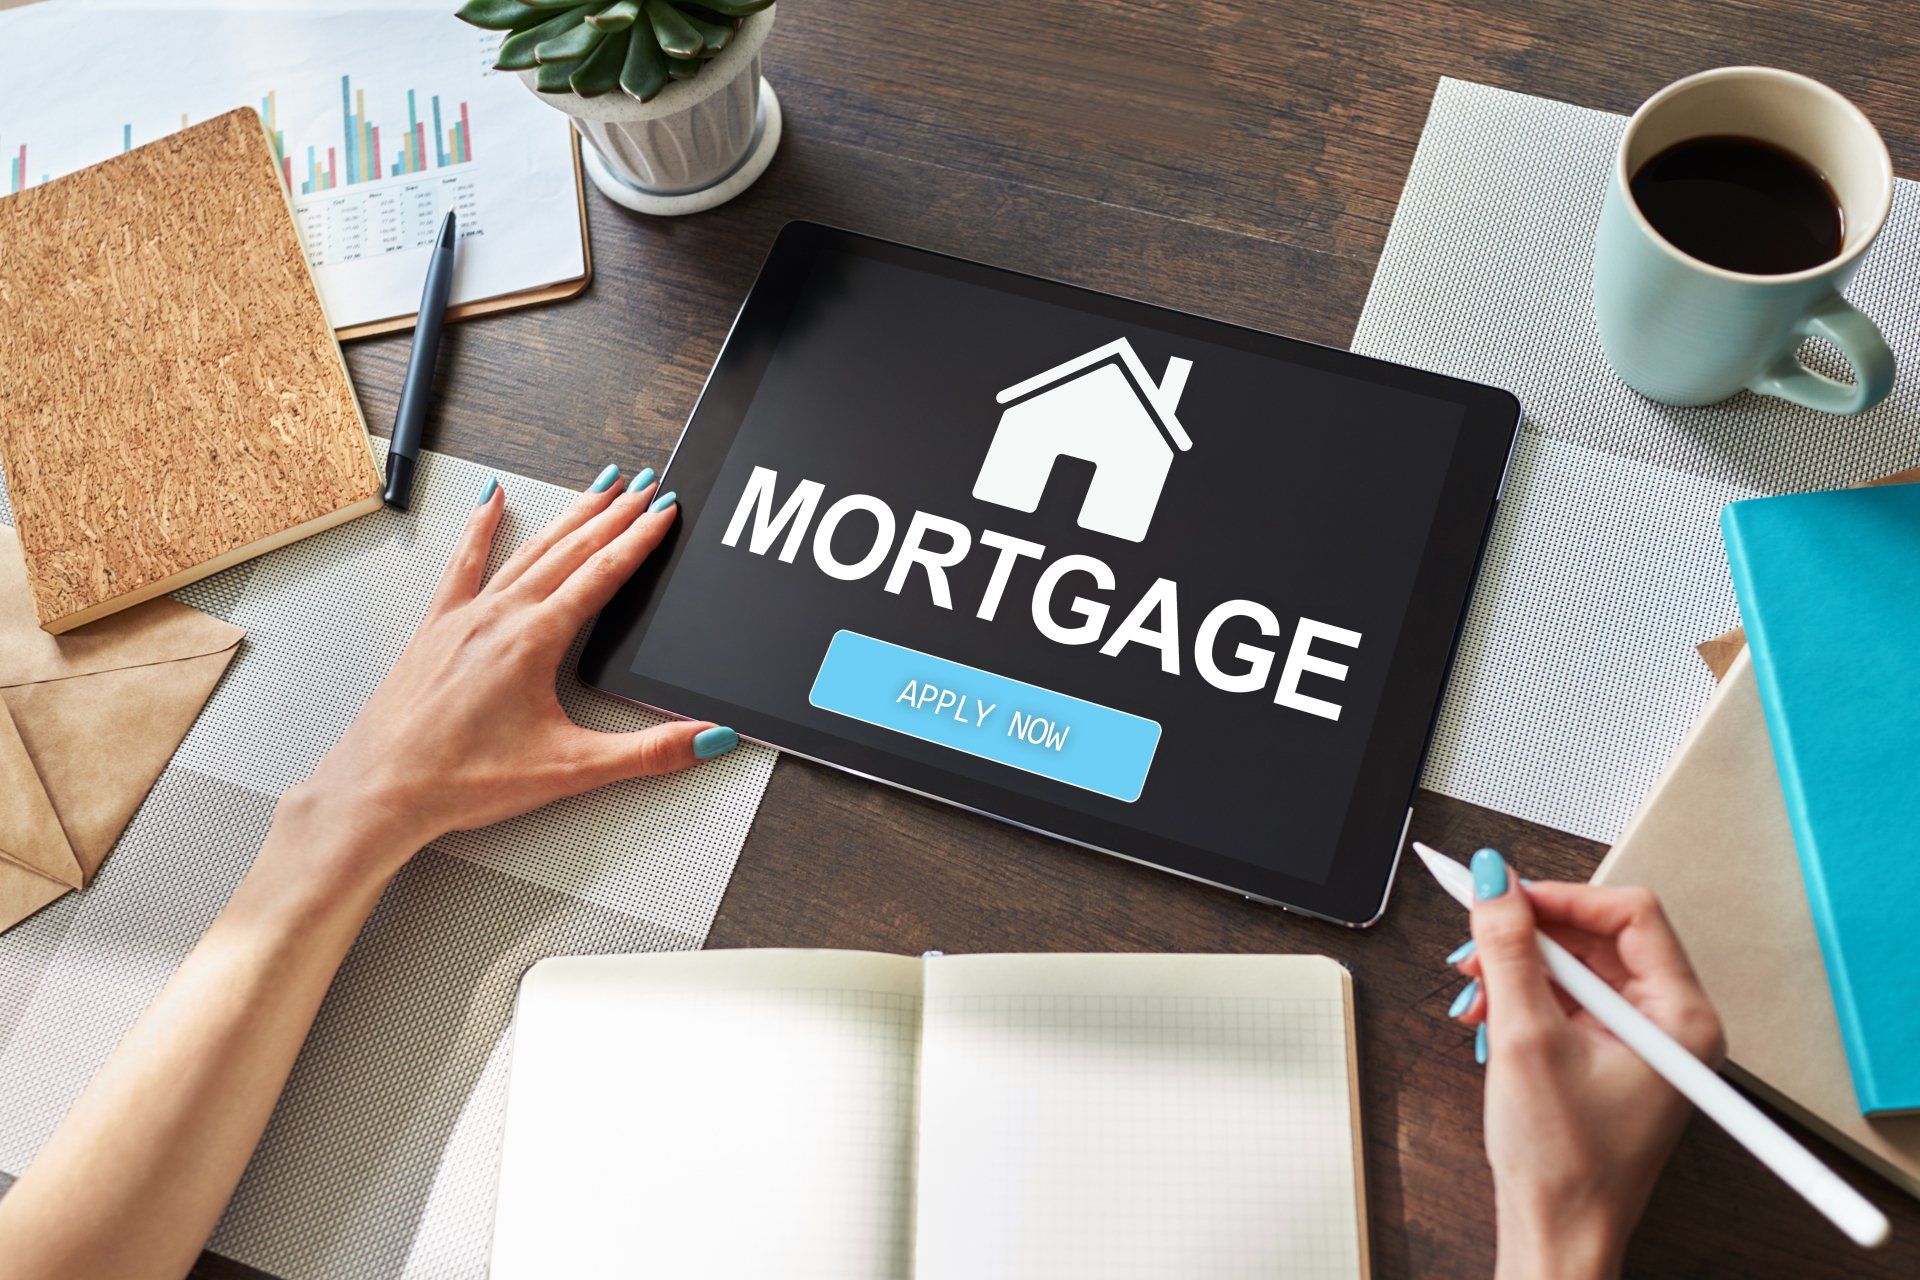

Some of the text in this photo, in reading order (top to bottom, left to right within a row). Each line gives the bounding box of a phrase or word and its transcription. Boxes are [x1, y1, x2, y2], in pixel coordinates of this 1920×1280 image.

[721, 466, 1362, 721] MORTGAGE
[896, 680, 1070, 752] APPLY NOW
